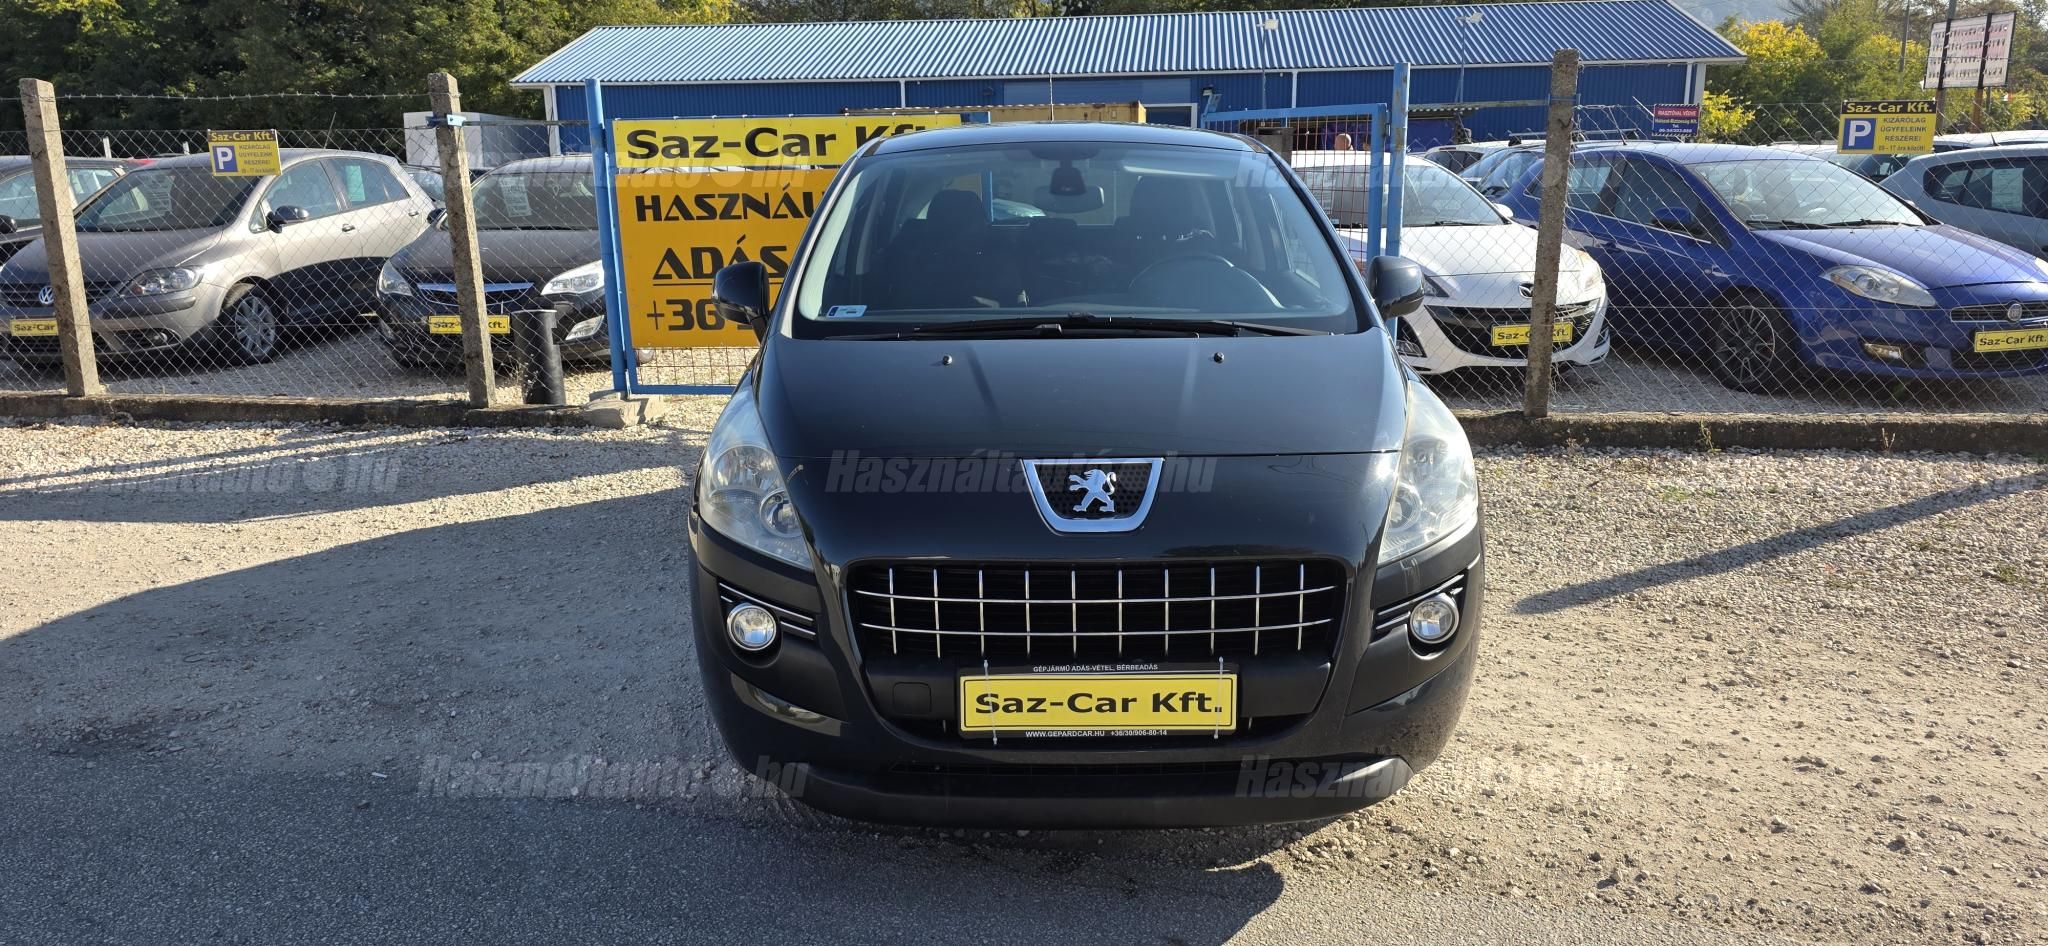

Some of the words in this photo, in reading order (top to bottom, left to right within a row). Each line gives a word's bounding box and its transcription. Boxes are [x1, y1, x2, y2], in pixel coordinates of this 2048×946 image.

[1846, 102, 1903, 113] Saz-Car
[1906, 102, 1933, 113] Kft.
[211, 132, 251, 141] Saz-Car
[254, 131, 274, 141] Kft.
[1848, 120, 1872, 147] P
[626, 127, 836, 160] Saz-Car
[216, 147, 233, 170] P
[14, 323, 56, 332] Saz-Car
[1979, 336, 2025, 346] Saz-Car
[2028, 334, 2047, 343] Kft.
[1116, 664, 1159, 672] BÉRBEADÁS
[975, 692, 1138, 714] Saz-Car
[1151, 691, 1223, 713] Kft.
